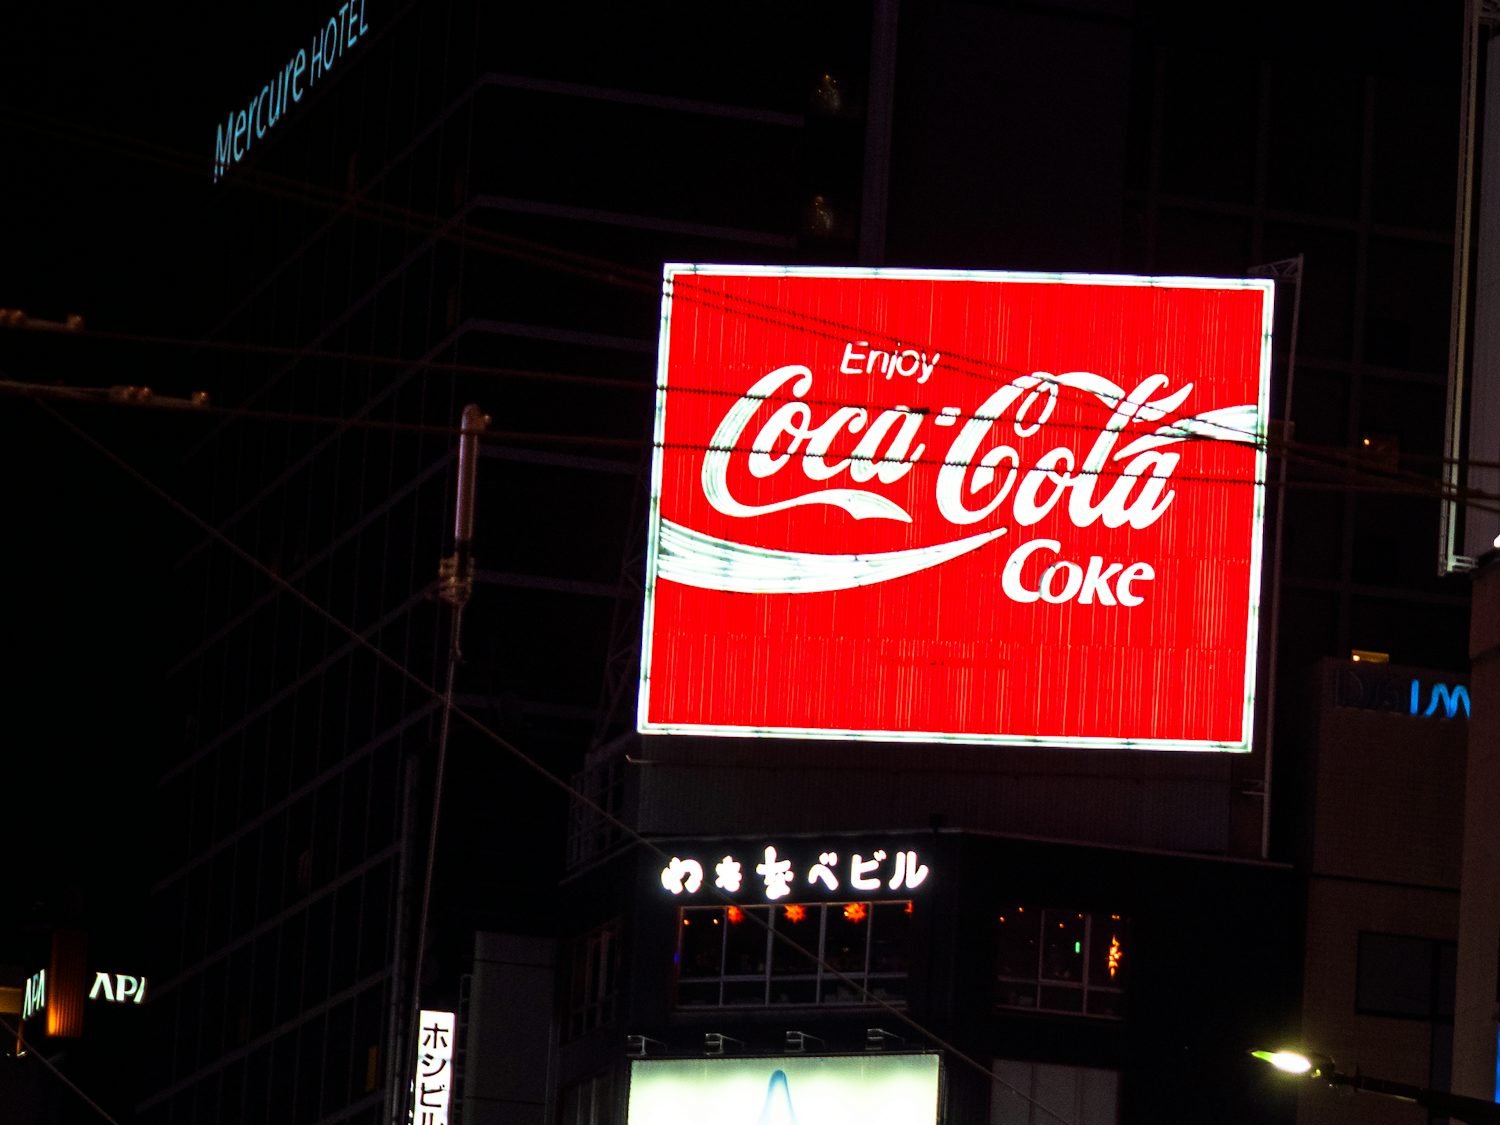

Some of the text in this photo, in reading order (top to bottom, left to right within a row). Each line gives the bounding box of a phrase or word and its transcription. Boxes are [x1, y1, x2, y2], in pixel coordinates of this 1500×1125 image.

[213, 0, 369, 183] Mercure HOTEL
[840, 340, 940, 384] Enjoy
[701, 364, 1193, 530] Coca-Cola
[1001, 537, 1155, 607] Coke
